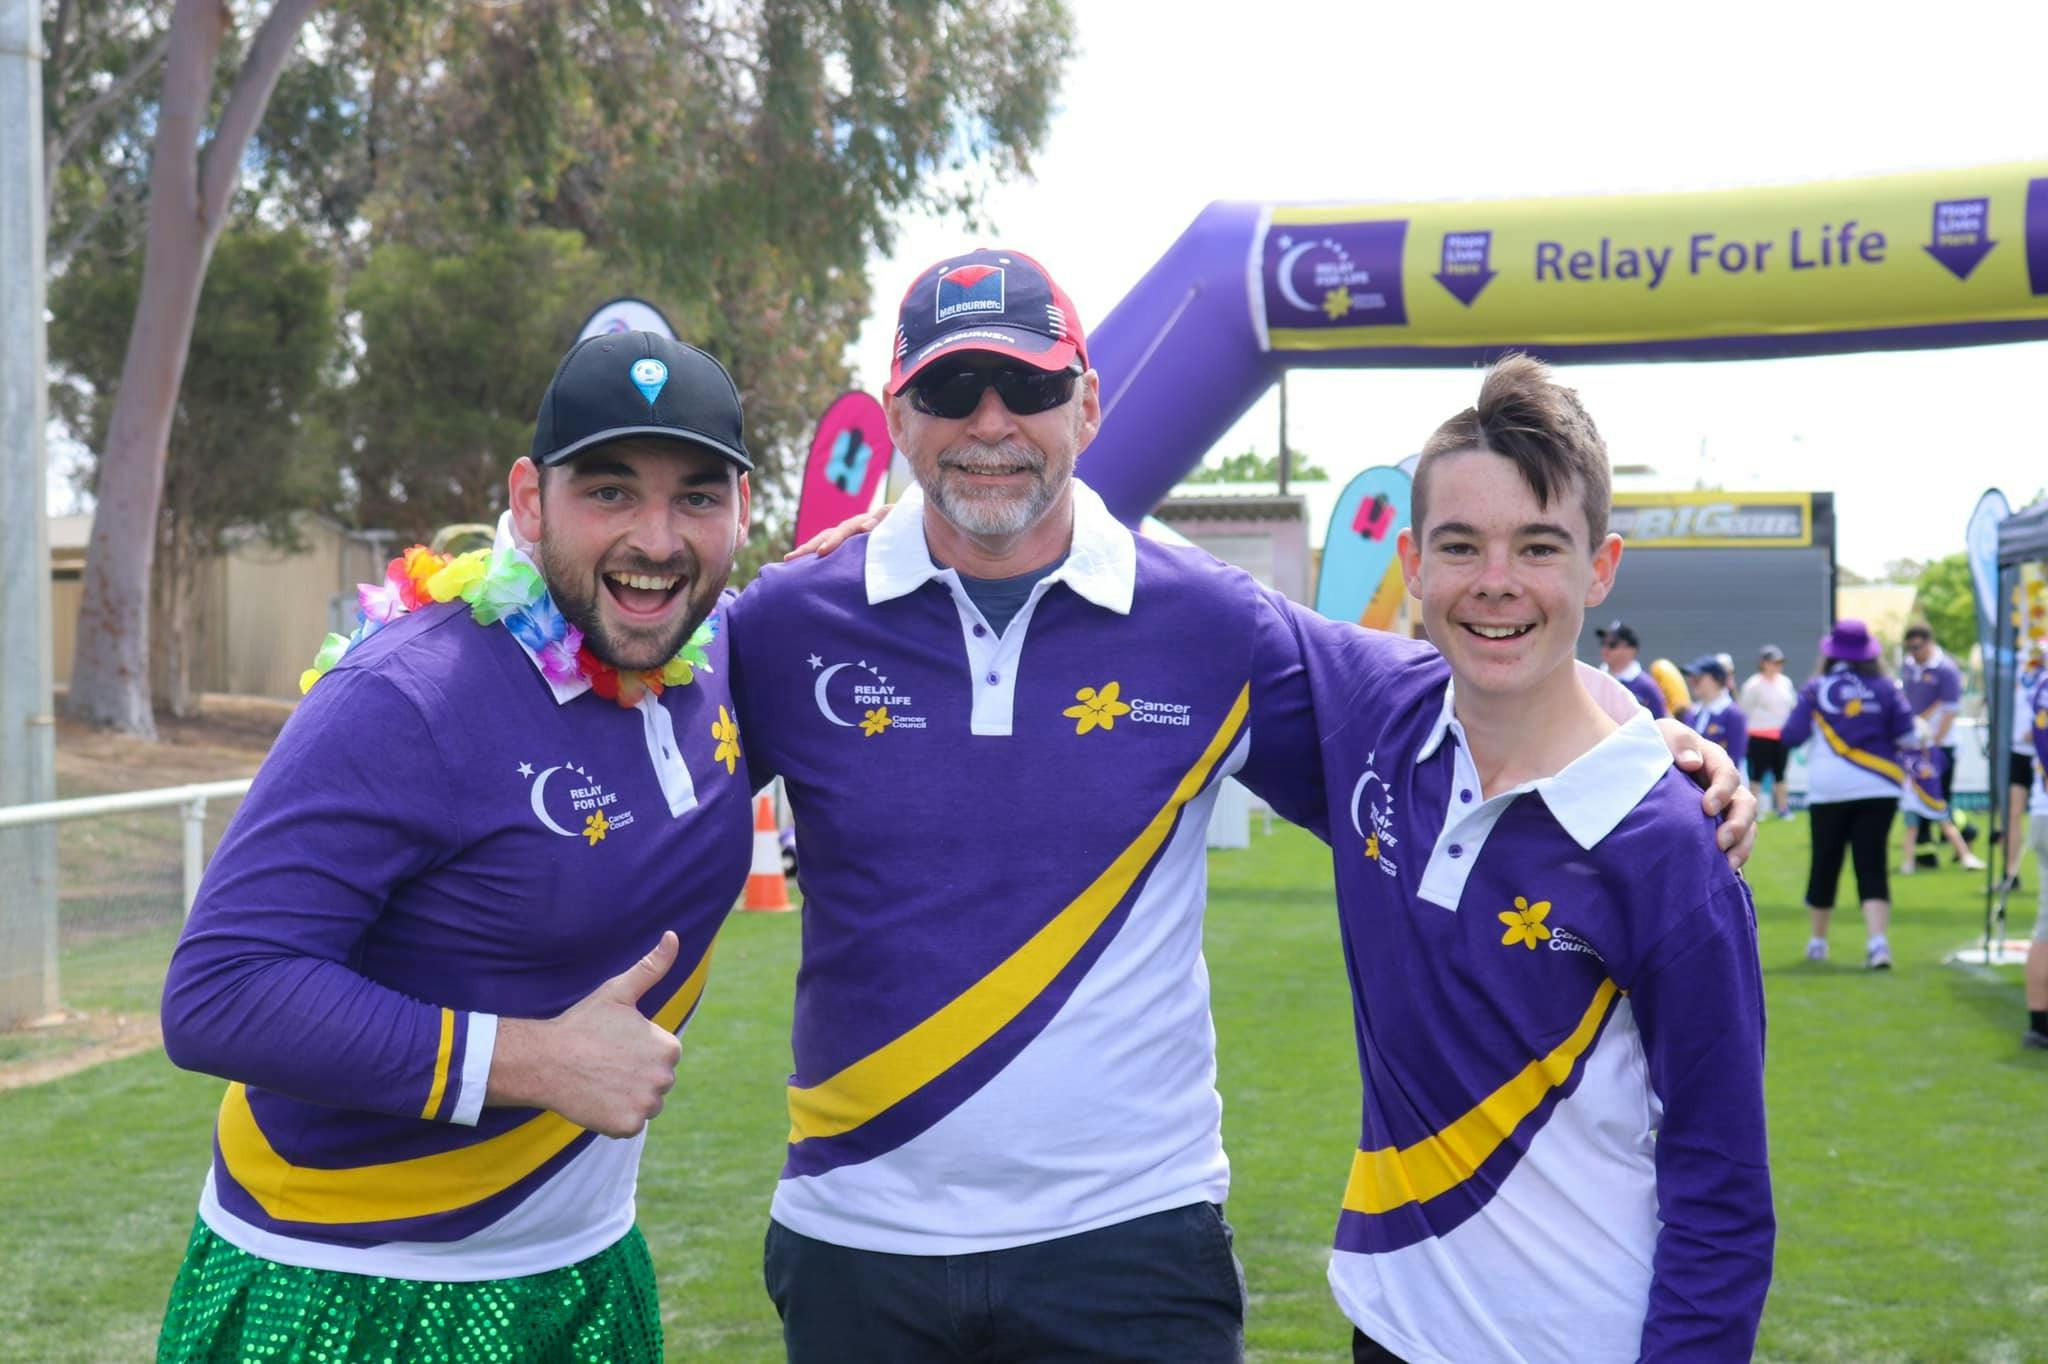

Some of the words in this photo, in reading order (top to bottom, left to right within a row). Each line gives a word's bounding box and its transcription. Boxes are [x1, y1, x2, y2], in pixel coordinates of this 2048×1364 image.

[1535, 238, 1673, 290] Relay
[1689, 233, 1774, 275] For
[1790, 221, 1888, 271] Life
[854, 685, 895, 695] RELAY
[854, 695, 881, 705] FOR
[884, 695, 912, 706] LIFE
[1130, 698, 1192, 715] Cancer
[891, 714, 927, 723] Cancer
[1130, 709, 1191, 727] Council
[891, 721, 928, 730] Council
[570, 785, 602, 799] RELAY
[573, 799, 596, 811] FOR
[597, 793, 617, 806] LIFE
